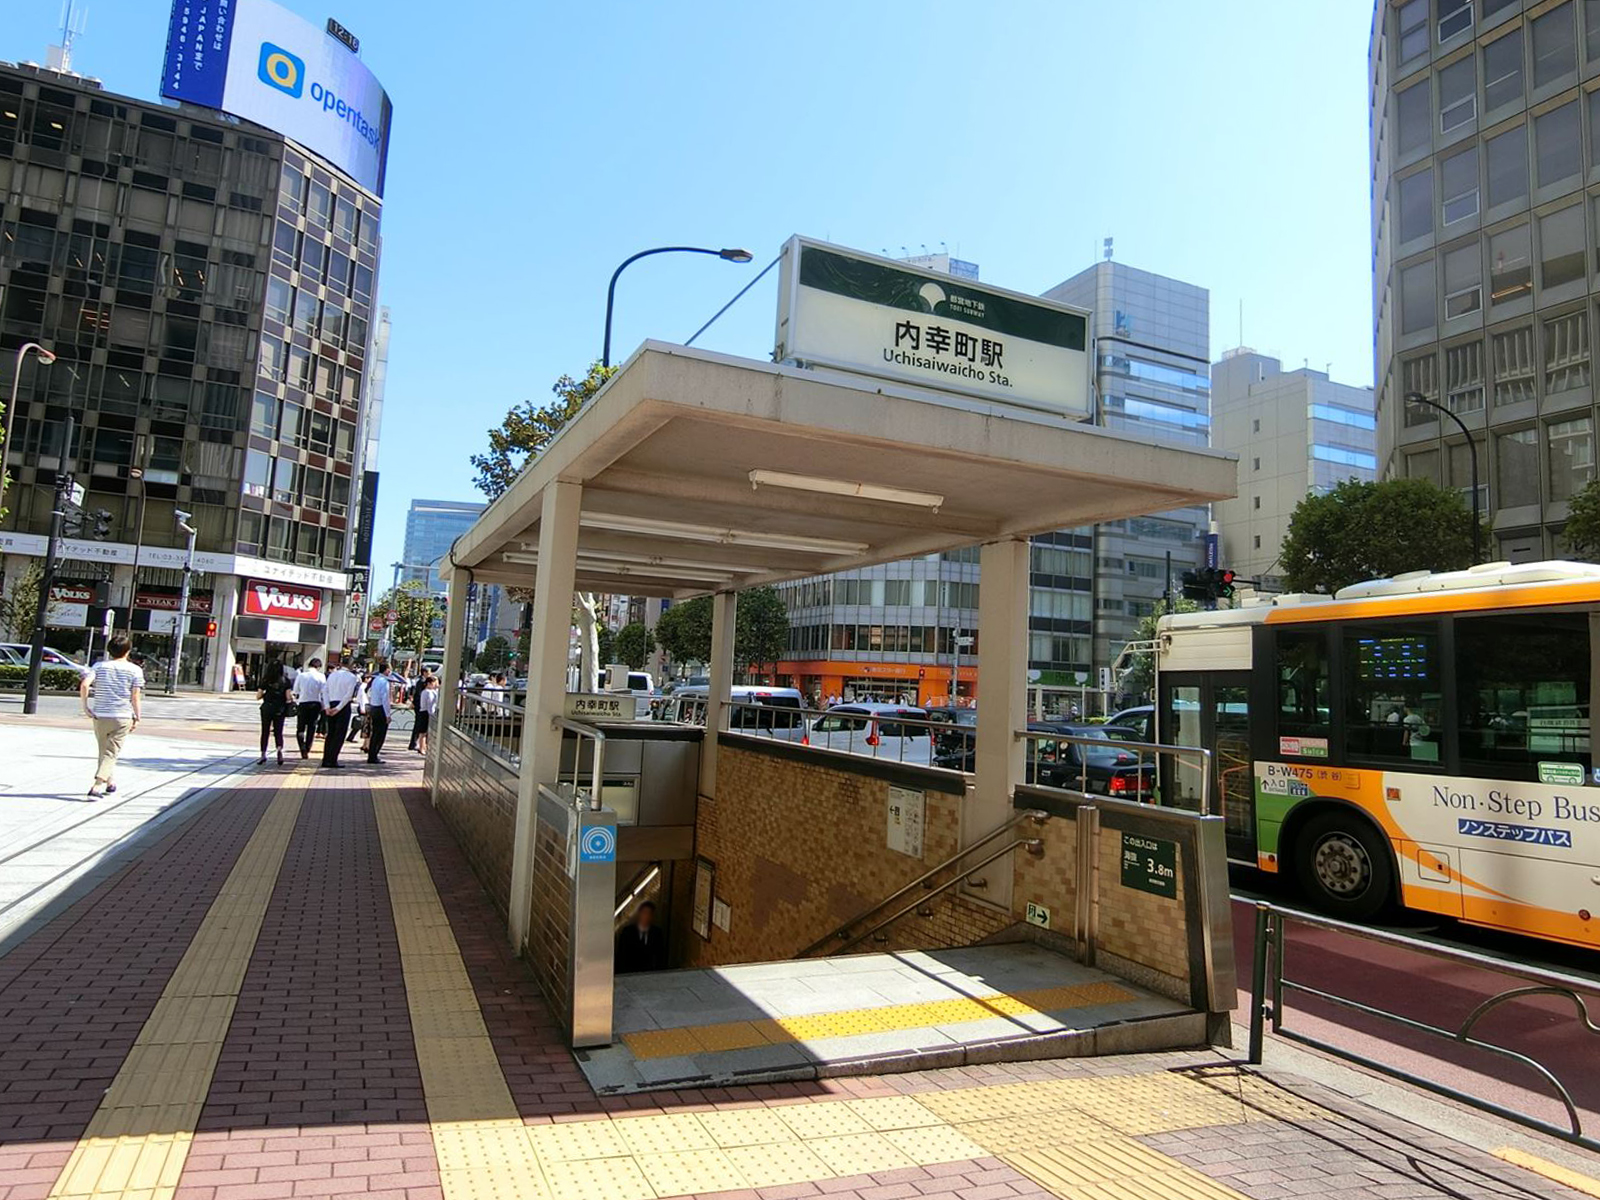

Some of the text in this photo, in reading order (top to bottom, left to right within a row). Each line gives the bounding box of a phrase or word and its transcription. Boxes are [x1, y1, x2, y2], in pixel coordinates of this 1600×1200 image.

[310, 82, 380, 150] opentask
[894, 320, 1004, 369] 内幸町駅
[883, 348, 1013, 387] Uchisaiwaicho Sta.
[255, 585, 315, 612] VOLKS
[575, 700, 620, 711] 内幸町駅
[1267, 765, 1313, 779] B-W475
[1270, 778, 1286, 788] 入口
[1552, 795, 1600, 822] Bus
[1459, 820, 1571, 847] ノンステップバス
[1147, 858, 1173, 878] 3.8m
